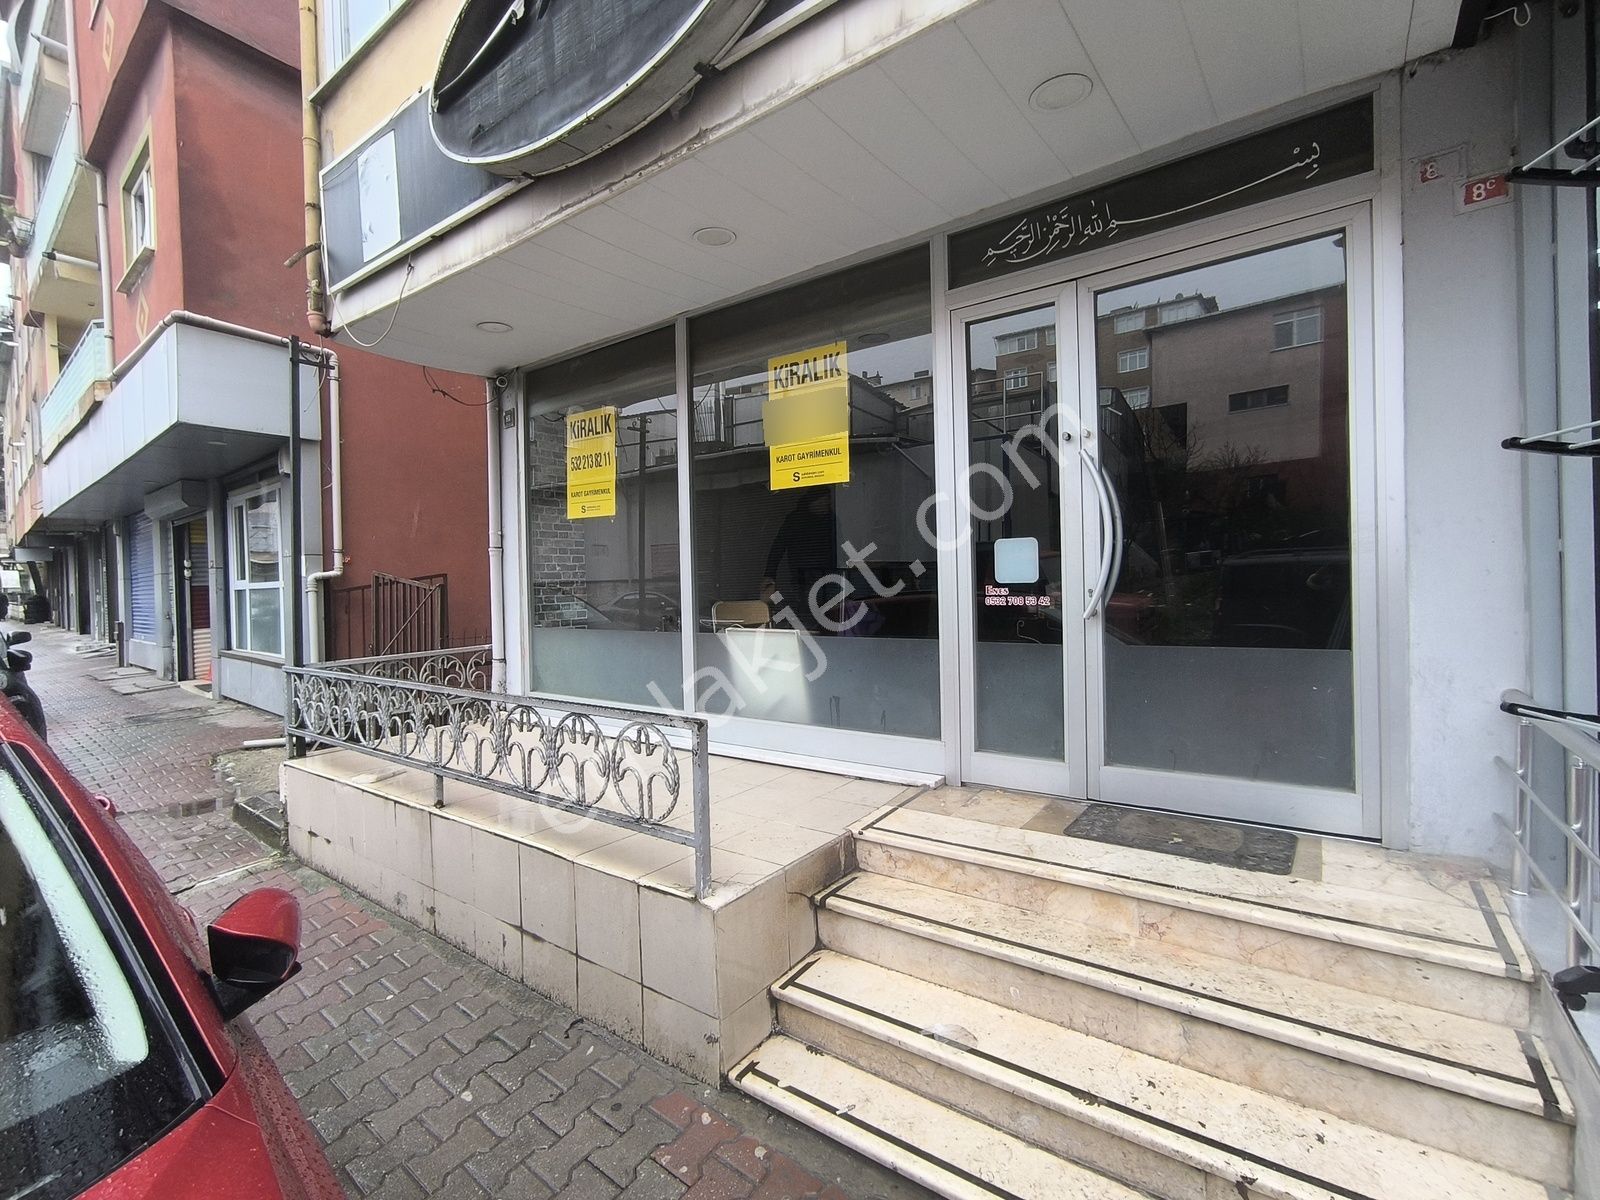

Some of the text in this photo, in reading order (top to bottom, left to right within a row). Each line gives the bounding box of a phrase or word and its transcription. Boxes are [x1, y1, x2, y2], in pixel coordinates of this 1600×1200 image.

[582, 453, 594, 470] 213
[594, 452, 602, 468] 82
[603, 451, 611, 467] 11
[776, 446, 842, 464] KAROT GAYRİMENKUL
[985, 596, 1006, 606] 0532
[1038, 596, 1051, 606] 42
